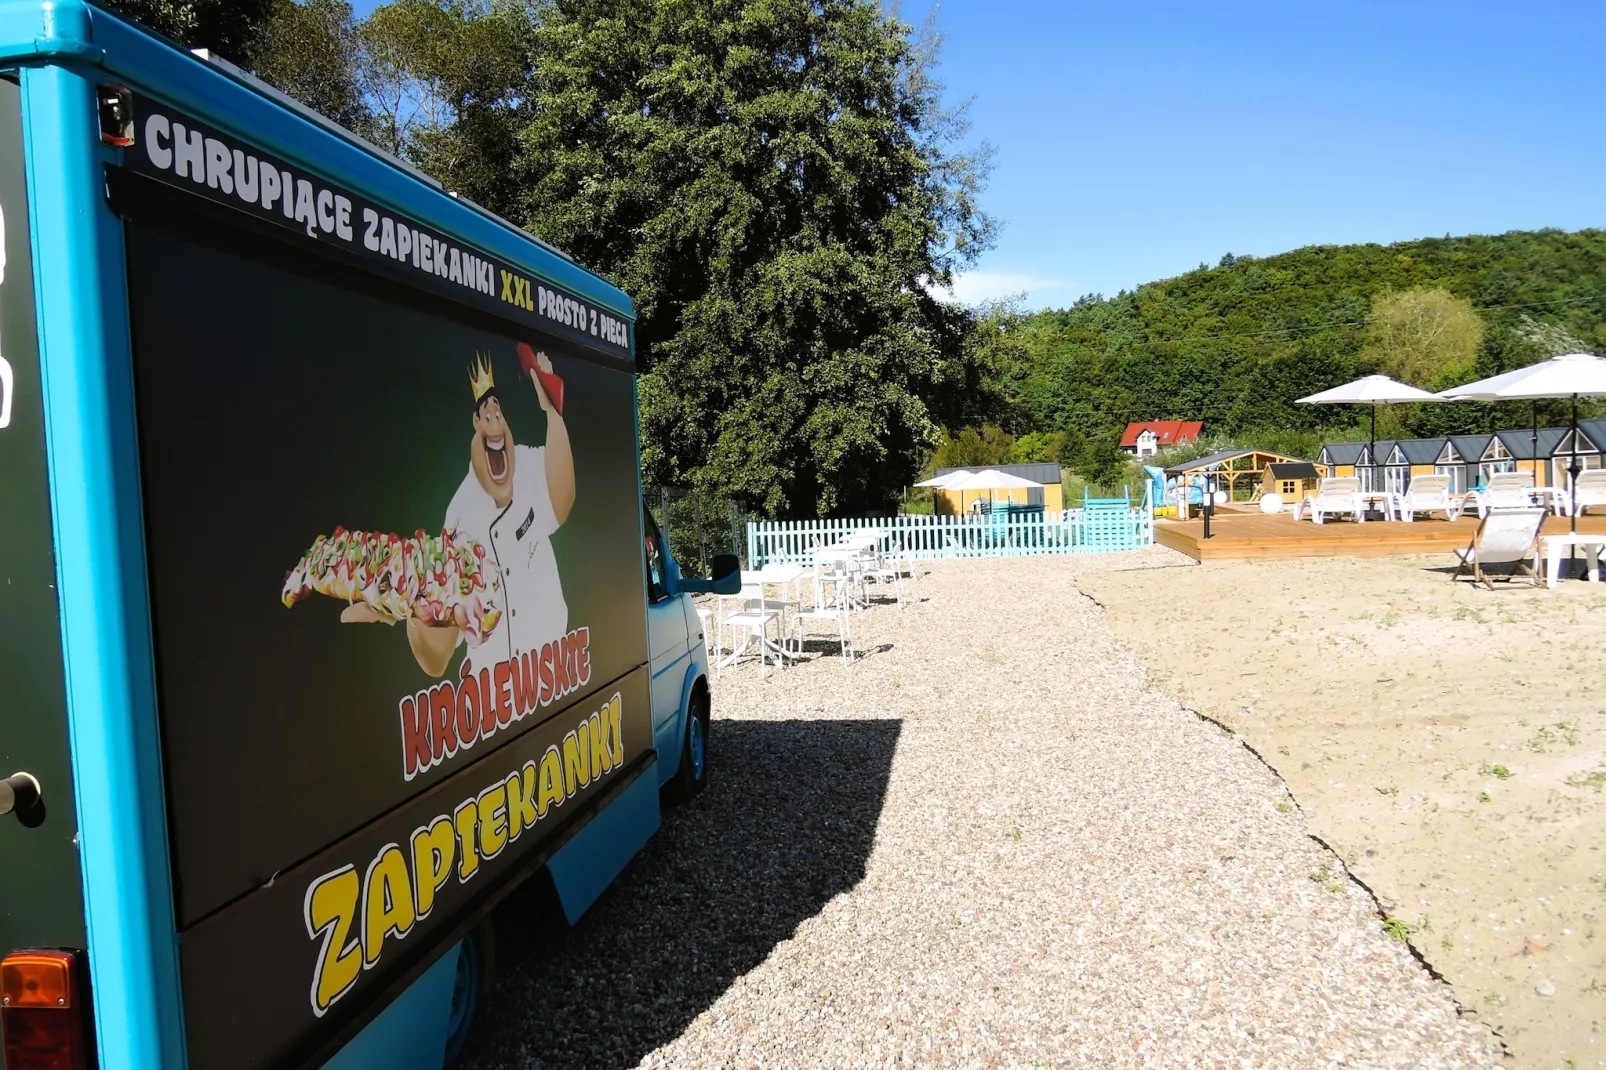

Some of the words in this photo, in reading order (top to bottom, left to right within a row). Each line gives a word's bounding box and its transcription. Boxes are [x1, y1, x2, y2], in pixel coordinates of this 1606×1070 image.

[146, 115, 353, 240] CHRUPIĄCE
[363, 208, 495, 297] ZAPIEKANKI
[501, 270, 534, 311] XXL
[538, 286, 587, 331] PROSTO
[590, 316, 599, 336] Z
[600, 315, 629, 349] PIECA
[400, 627, 592, 781] KRÓLEWSKIE
[304, 691, 624, 1018] ZAPIEKANKI
